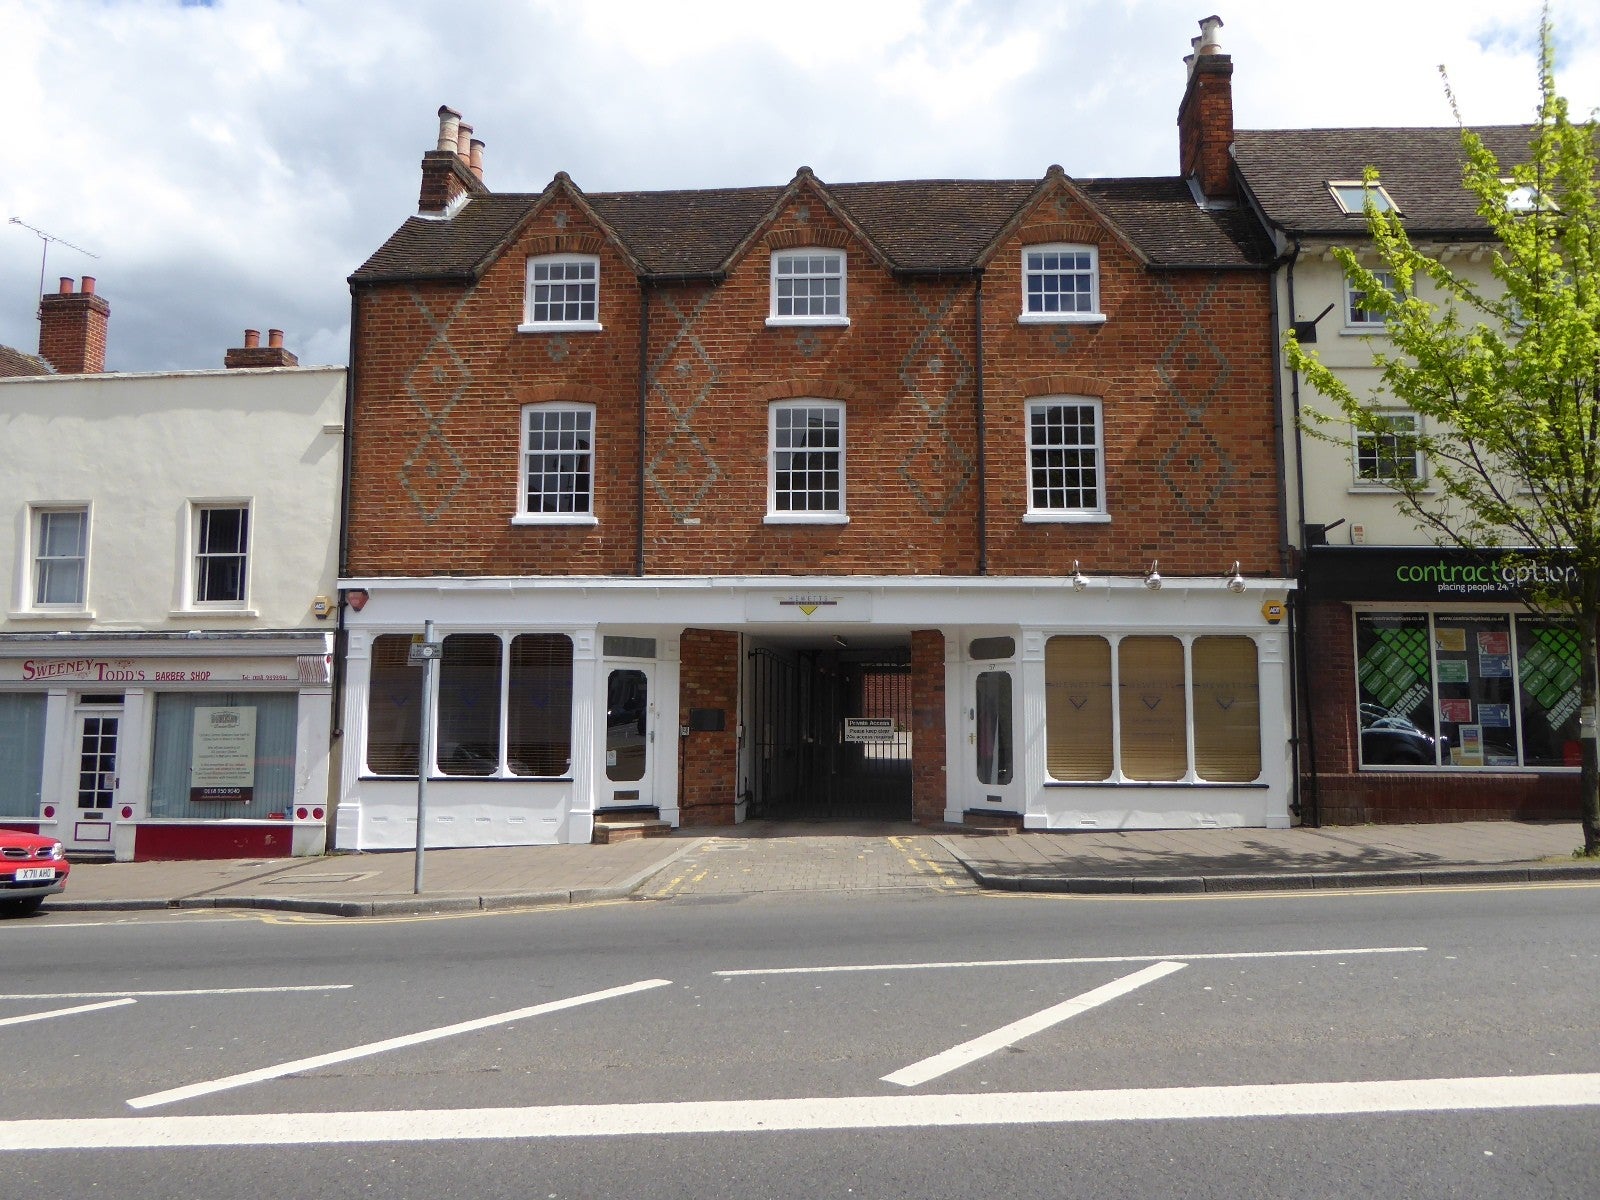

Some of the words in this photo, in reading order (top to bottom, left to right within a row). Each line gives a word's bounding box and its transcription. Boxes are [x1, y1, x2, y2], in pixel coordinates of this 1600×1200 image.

[1438, 583, 1465, 592] placing
[1468, 583, 1494, 592] people
[23, 660, 94, 680] SWEENEY
[94, 662, 145, 681] TODD'S
[155, 671, 186, 681] BARBER
[190, 671, 211, 681] SHOP
